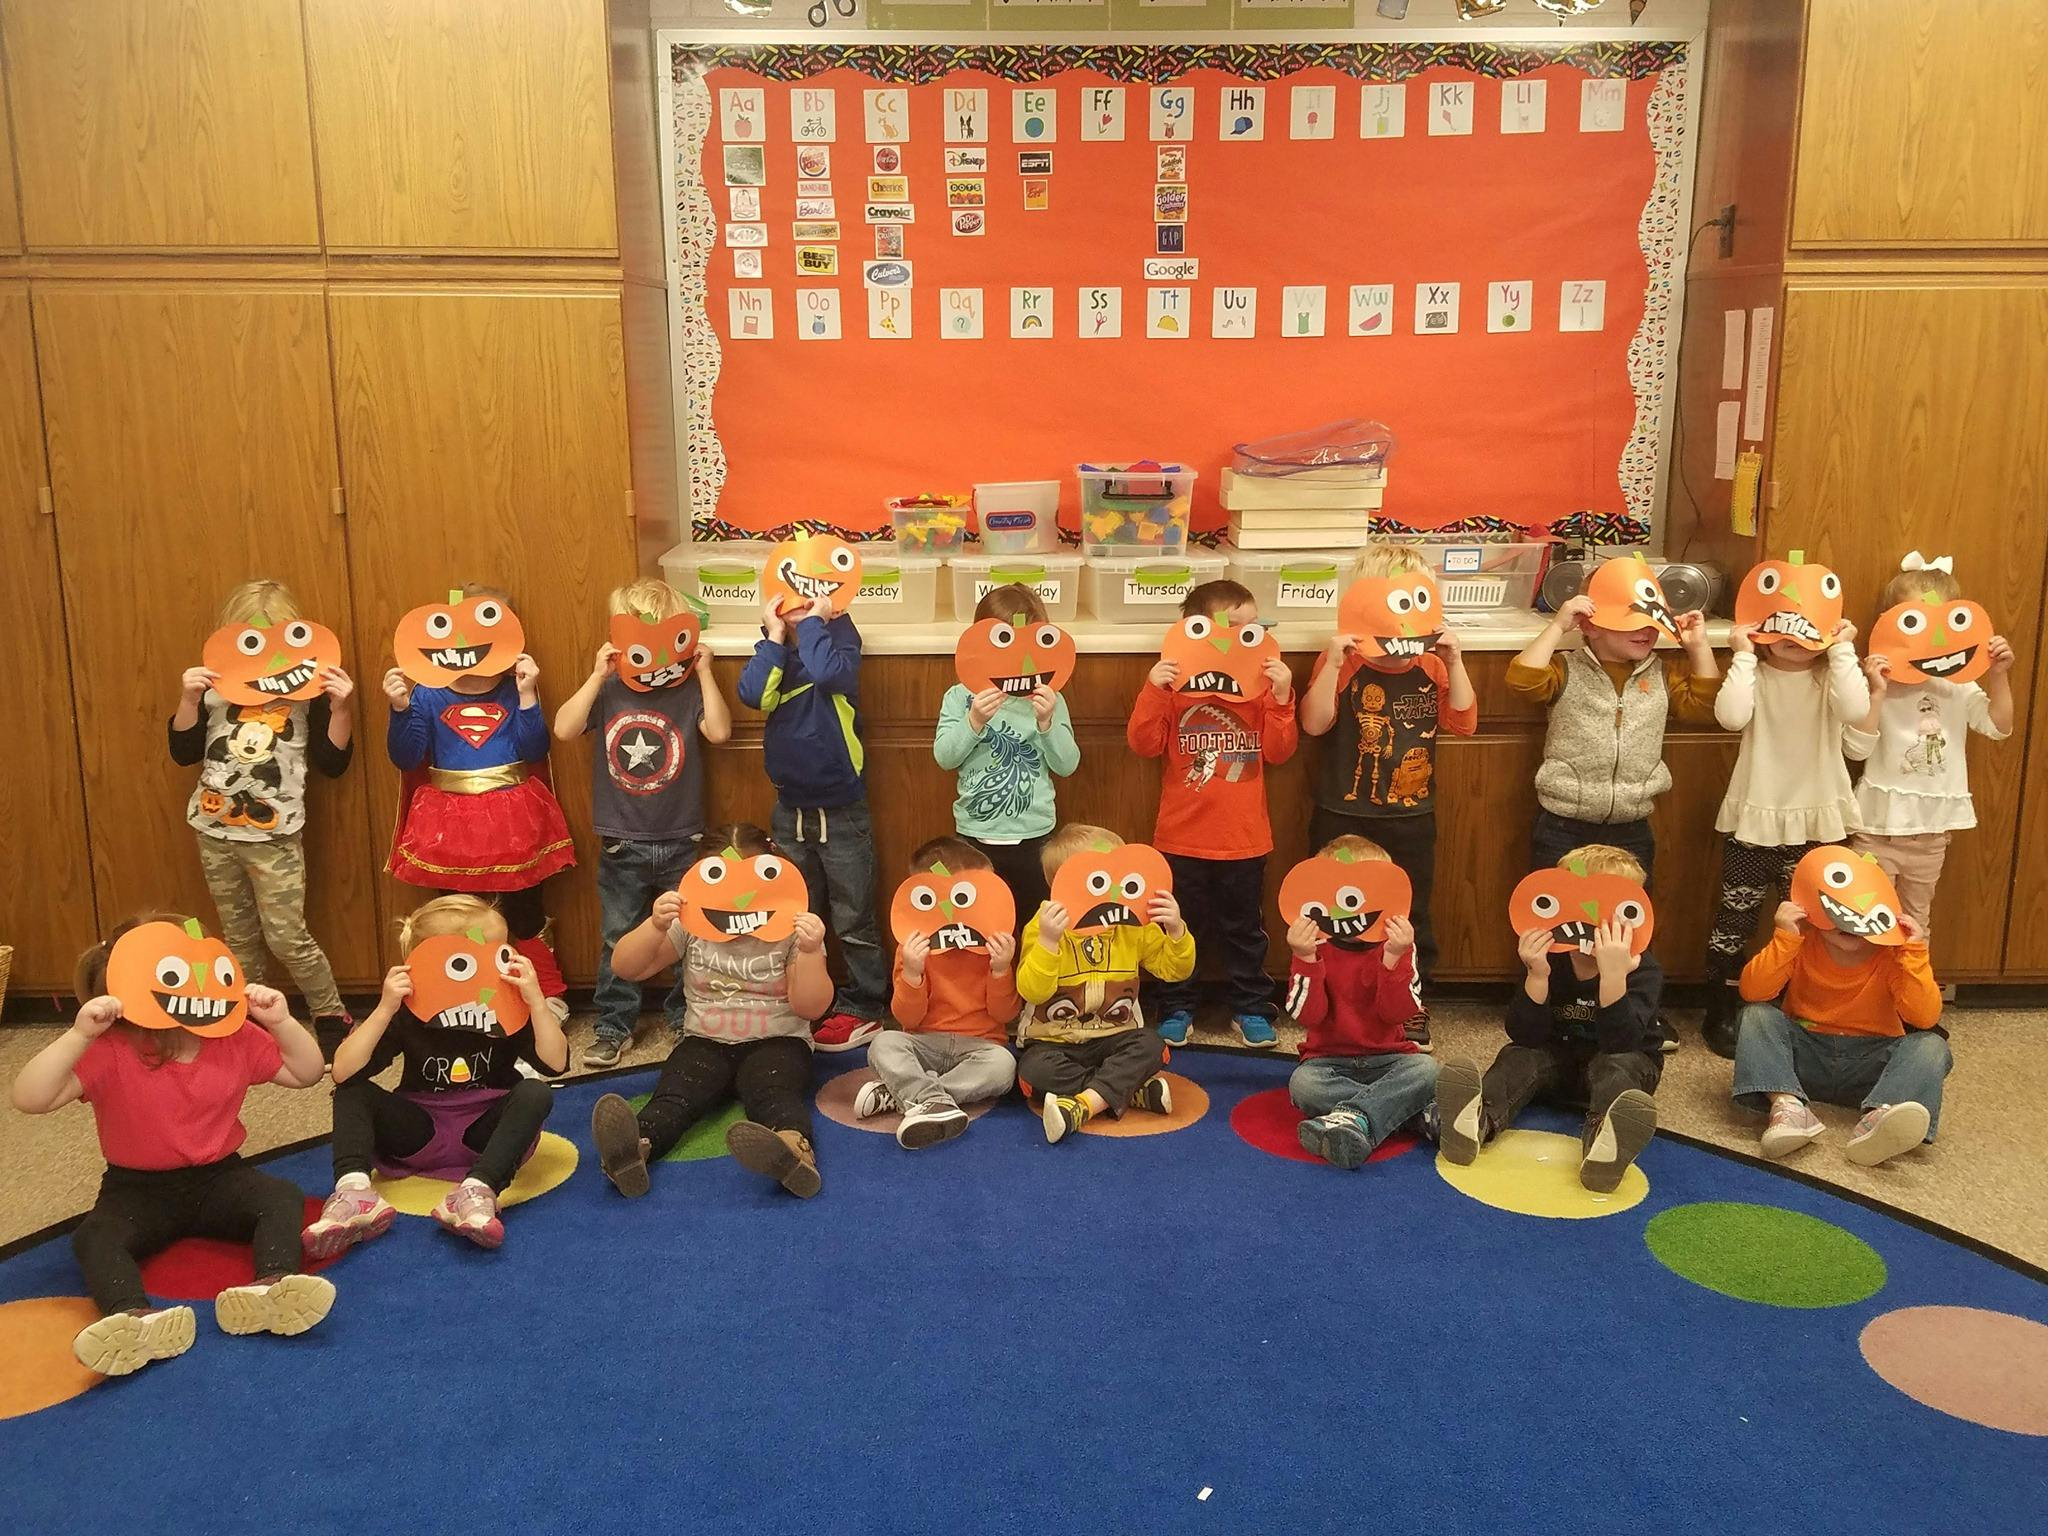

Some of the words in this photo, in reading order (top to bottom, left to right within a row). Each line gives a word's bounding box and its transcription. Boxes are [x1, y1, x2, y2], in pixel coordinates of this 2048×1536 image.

[1094, 90, 1113, 111] Ff
[1230, 89, 1255, 111] Hh
[1440, 84, 1463, 106] Kk
[1516, 83, 1531, 104] Ll
[1588, 81, 1621, 101] Mm
[730, 91, 755, 112] Aa
[804, 91, 825, 112] Bb
[875, 92, 897, 113] Cc
[954, 91, 976, 112] Dd
[1024, 92, 1046, 113] Ee
[1160, 89, 1185, 119] Gg
[803, 159, 827, 171] KING
[946, 150, 985, 170] Disney
[1021, 158, 1049, 168] ESPN
[871, 181, 904, 193] Cheerios
[950, 183, 981, 193] DOTS
[1157, 191, 1186, 206] Golden
[800, 202, 833, 216] Barbie
[867, 206, 911, 219] Crayola
[959, 217, 981, 230] Pepper
[1162, 231, 1179, 246] GAP
[803, 251, 832, 262] BEST
[804, 259, 831, 270] BUY
[871, 265, 902, 281] Culver's
[1146, 261, 1195, 280] Google
[739, 290, 762, 311] Nn
[807, 291, 830, 311] Oo
[1022, 290, 1041, 310] Rr
[1090, 290, 1108, 309] Ss
[1159, 289, 1179, 310] Tt
[1224, 289, 1247, 310] Uu
[1294, 290, 1318, 308] Vv
[1354, 287, 1389, 307] Ww
[1428, 286, 1450, 305] Xx
[1501, 284, 1521, 311] Yy
[1572, 283, 1593, 303] Zz
[880, 290, 900, 318] Pp
[949, 290, 976, 319] Qq
[702, 585, 756, 602] Monday
[855, 584, 899, 600] esday
[1128, 583, 1192, 601] Thursday
[1281, 584, 1335, 605] Friday
[1178, 731, 1262, 755] FOOTBALL
[690, 945, 785, 981] DANCE
[701, 1007, 770, 1037] OUT
